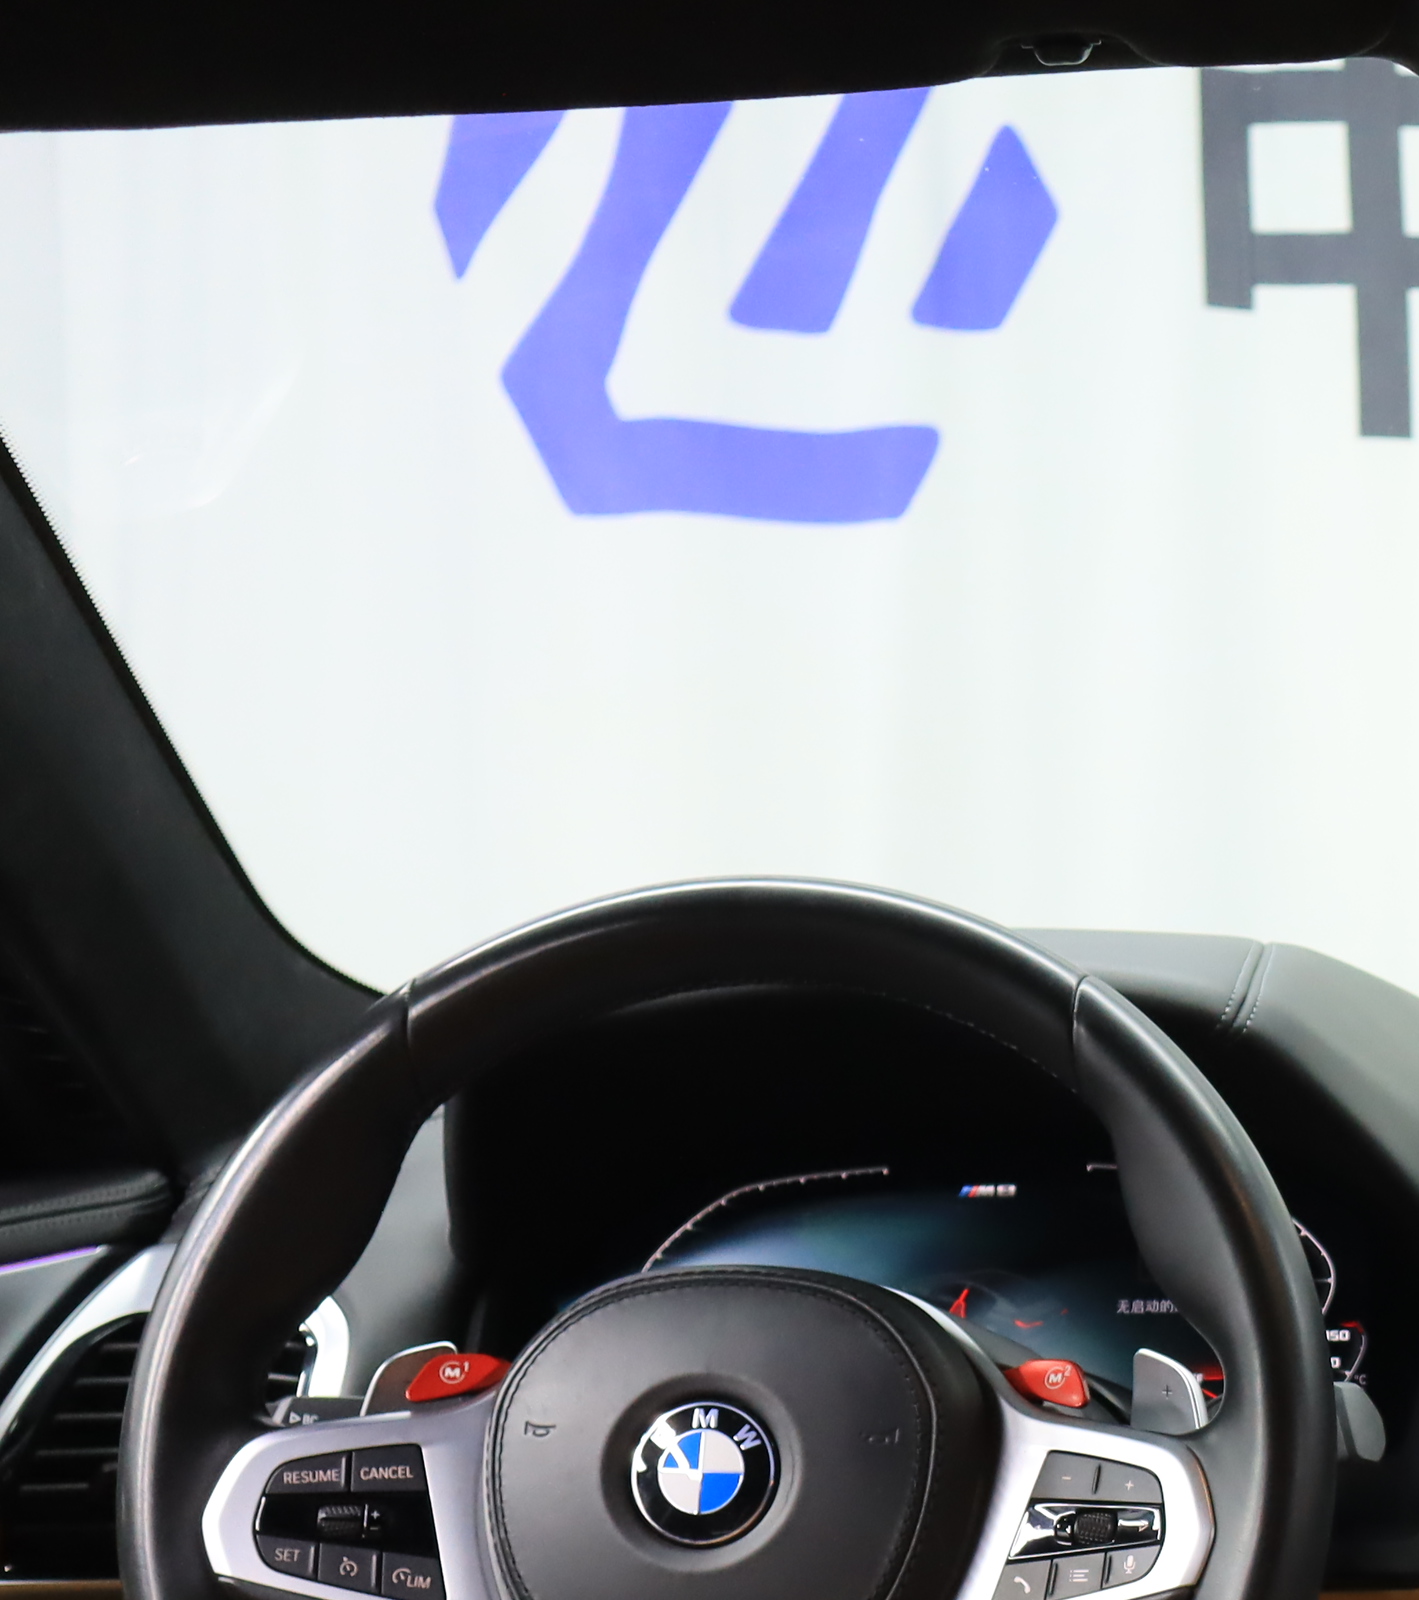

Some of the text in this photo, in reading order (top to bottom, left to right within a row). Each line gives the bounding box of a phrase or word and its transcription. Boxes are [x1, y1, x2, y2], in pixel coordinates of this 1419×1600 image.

[1117, 1299, 1178, 1315] 无启动的
[650, 1407, 762, 1451] BMW
[283, 1469, 341, 1484] RESUME
[360, 1465, 413, 1480] CANCEL
[274, 1548, 301, 1562] SET
[406, 1575, 432, 1589] LIM
